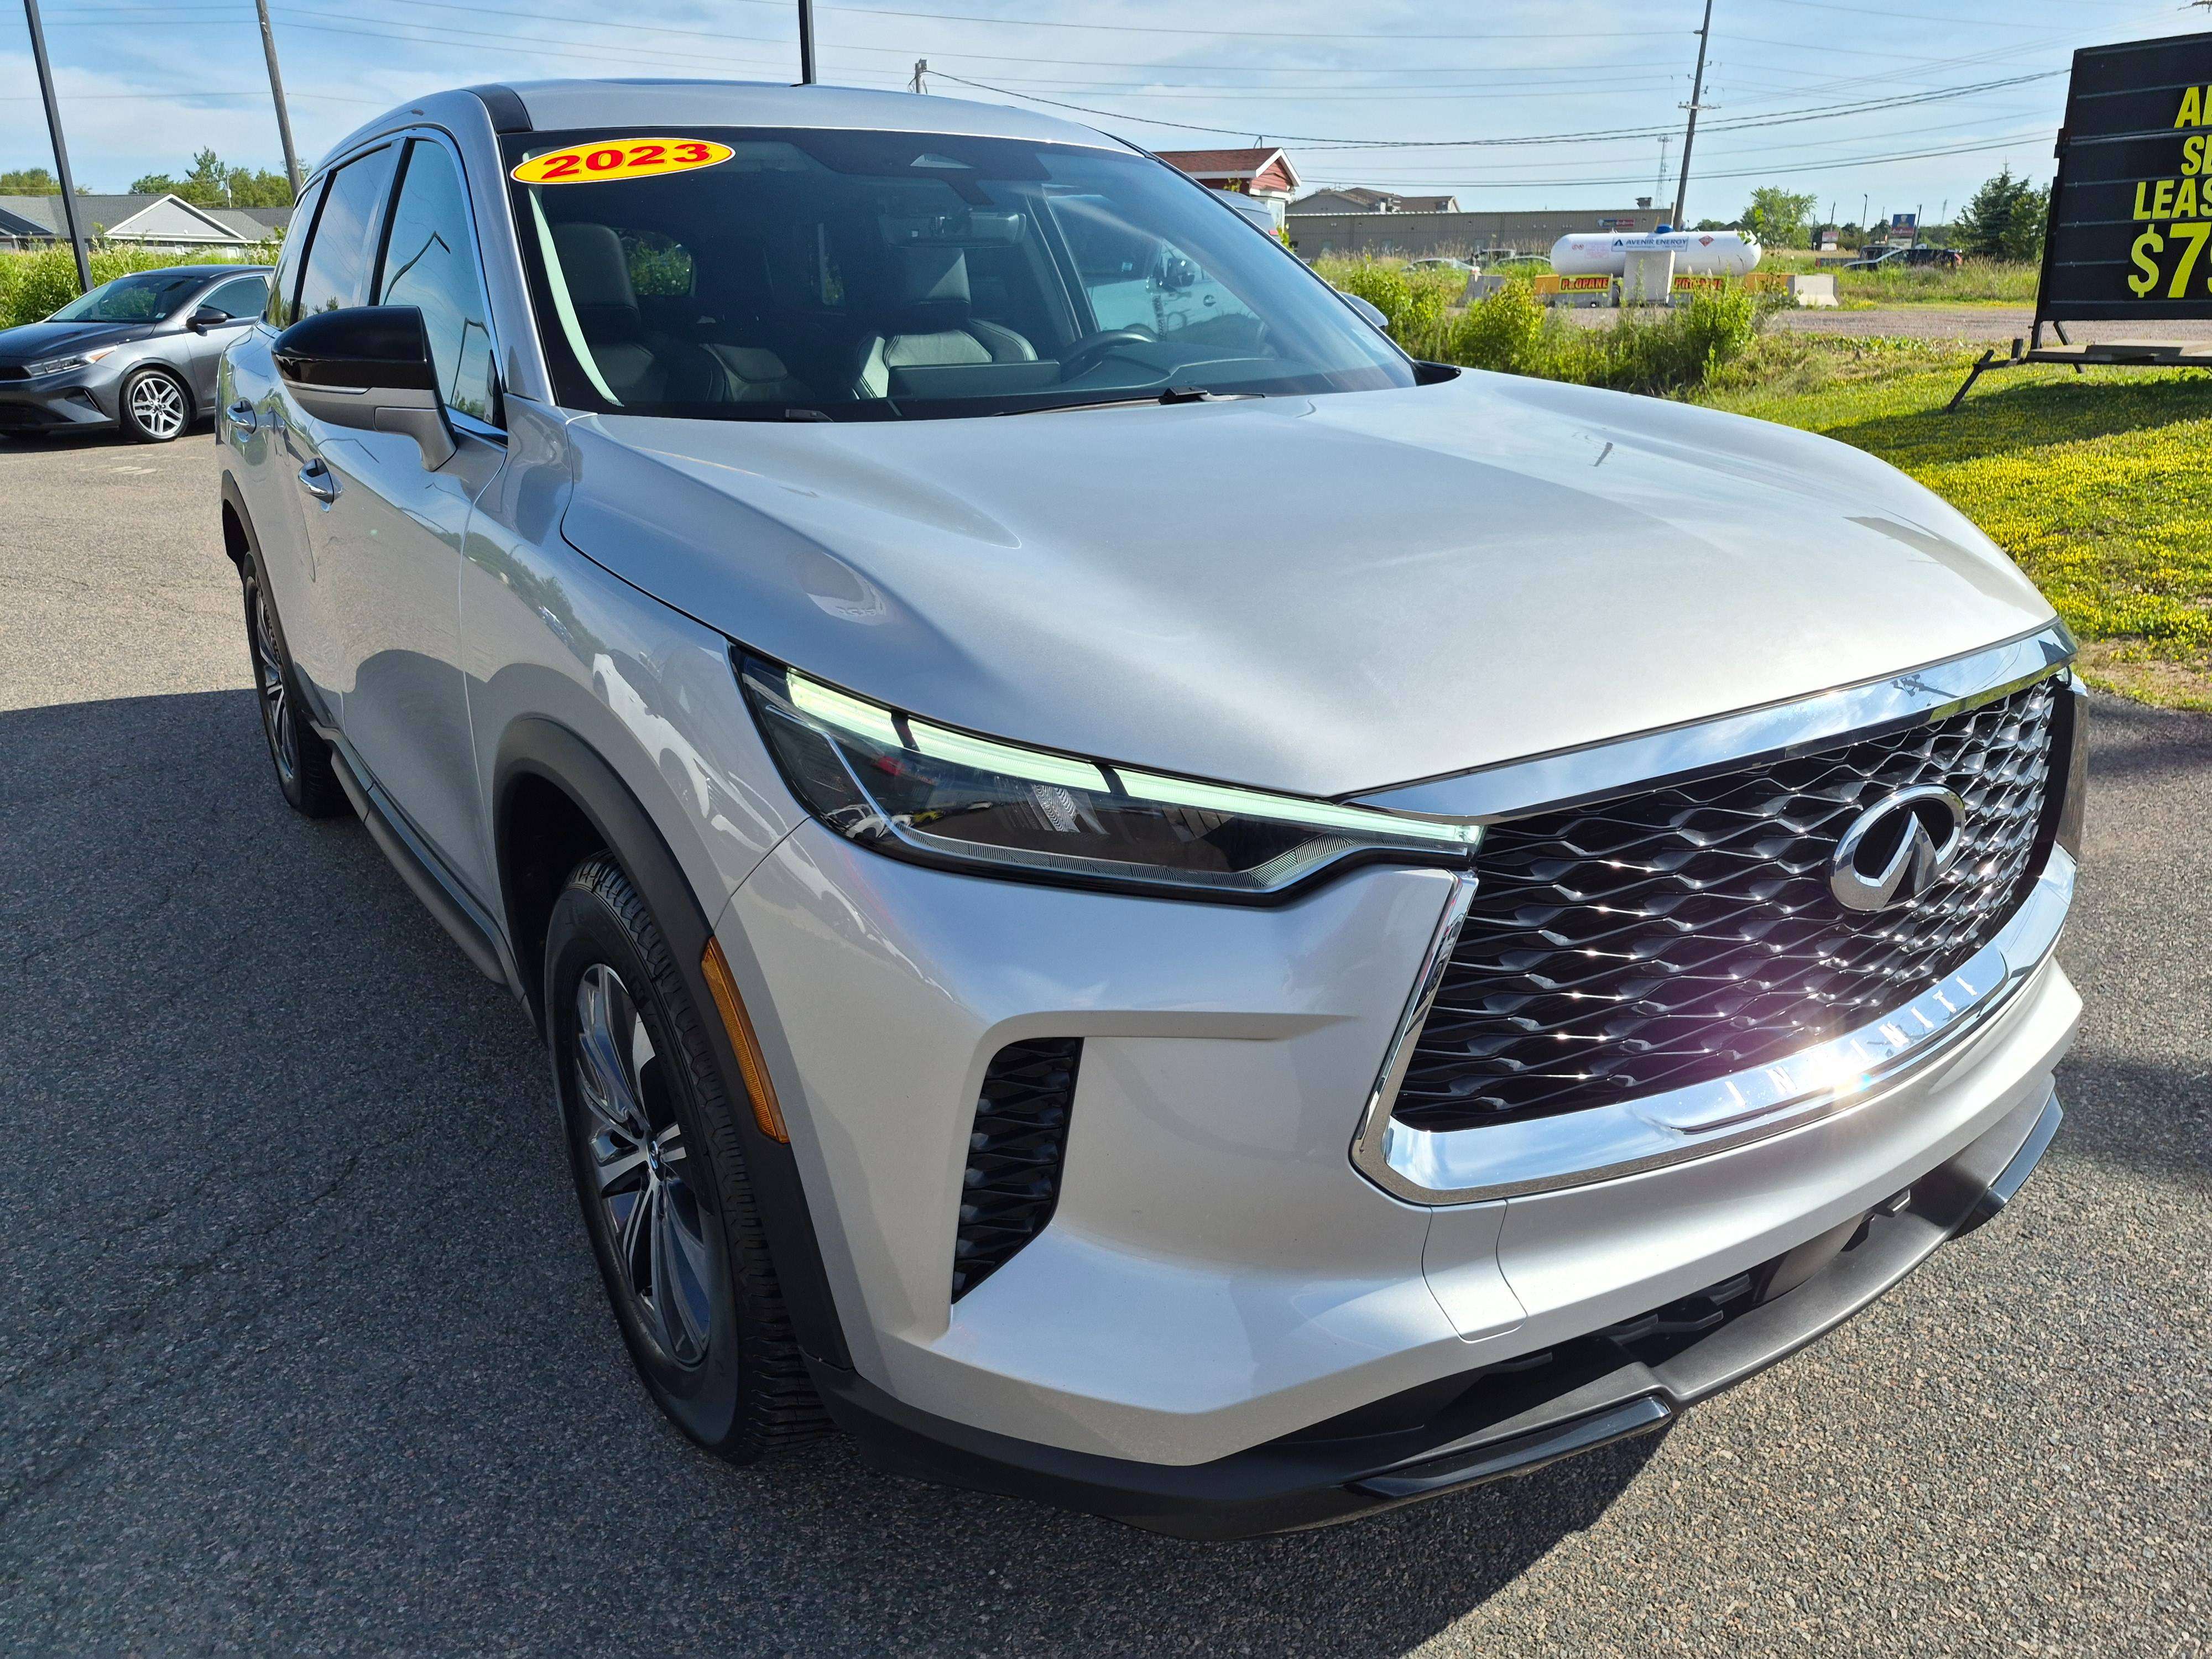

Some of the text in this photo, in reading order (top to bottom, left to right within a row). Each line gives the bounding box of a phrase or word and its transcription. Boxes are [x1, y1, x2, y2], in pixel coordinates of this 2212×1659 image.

[541, 144, 712, 179] 2023
[2128, 222, 2212, 298] $7
[1725, 975, 1978, 1107] ININITI
